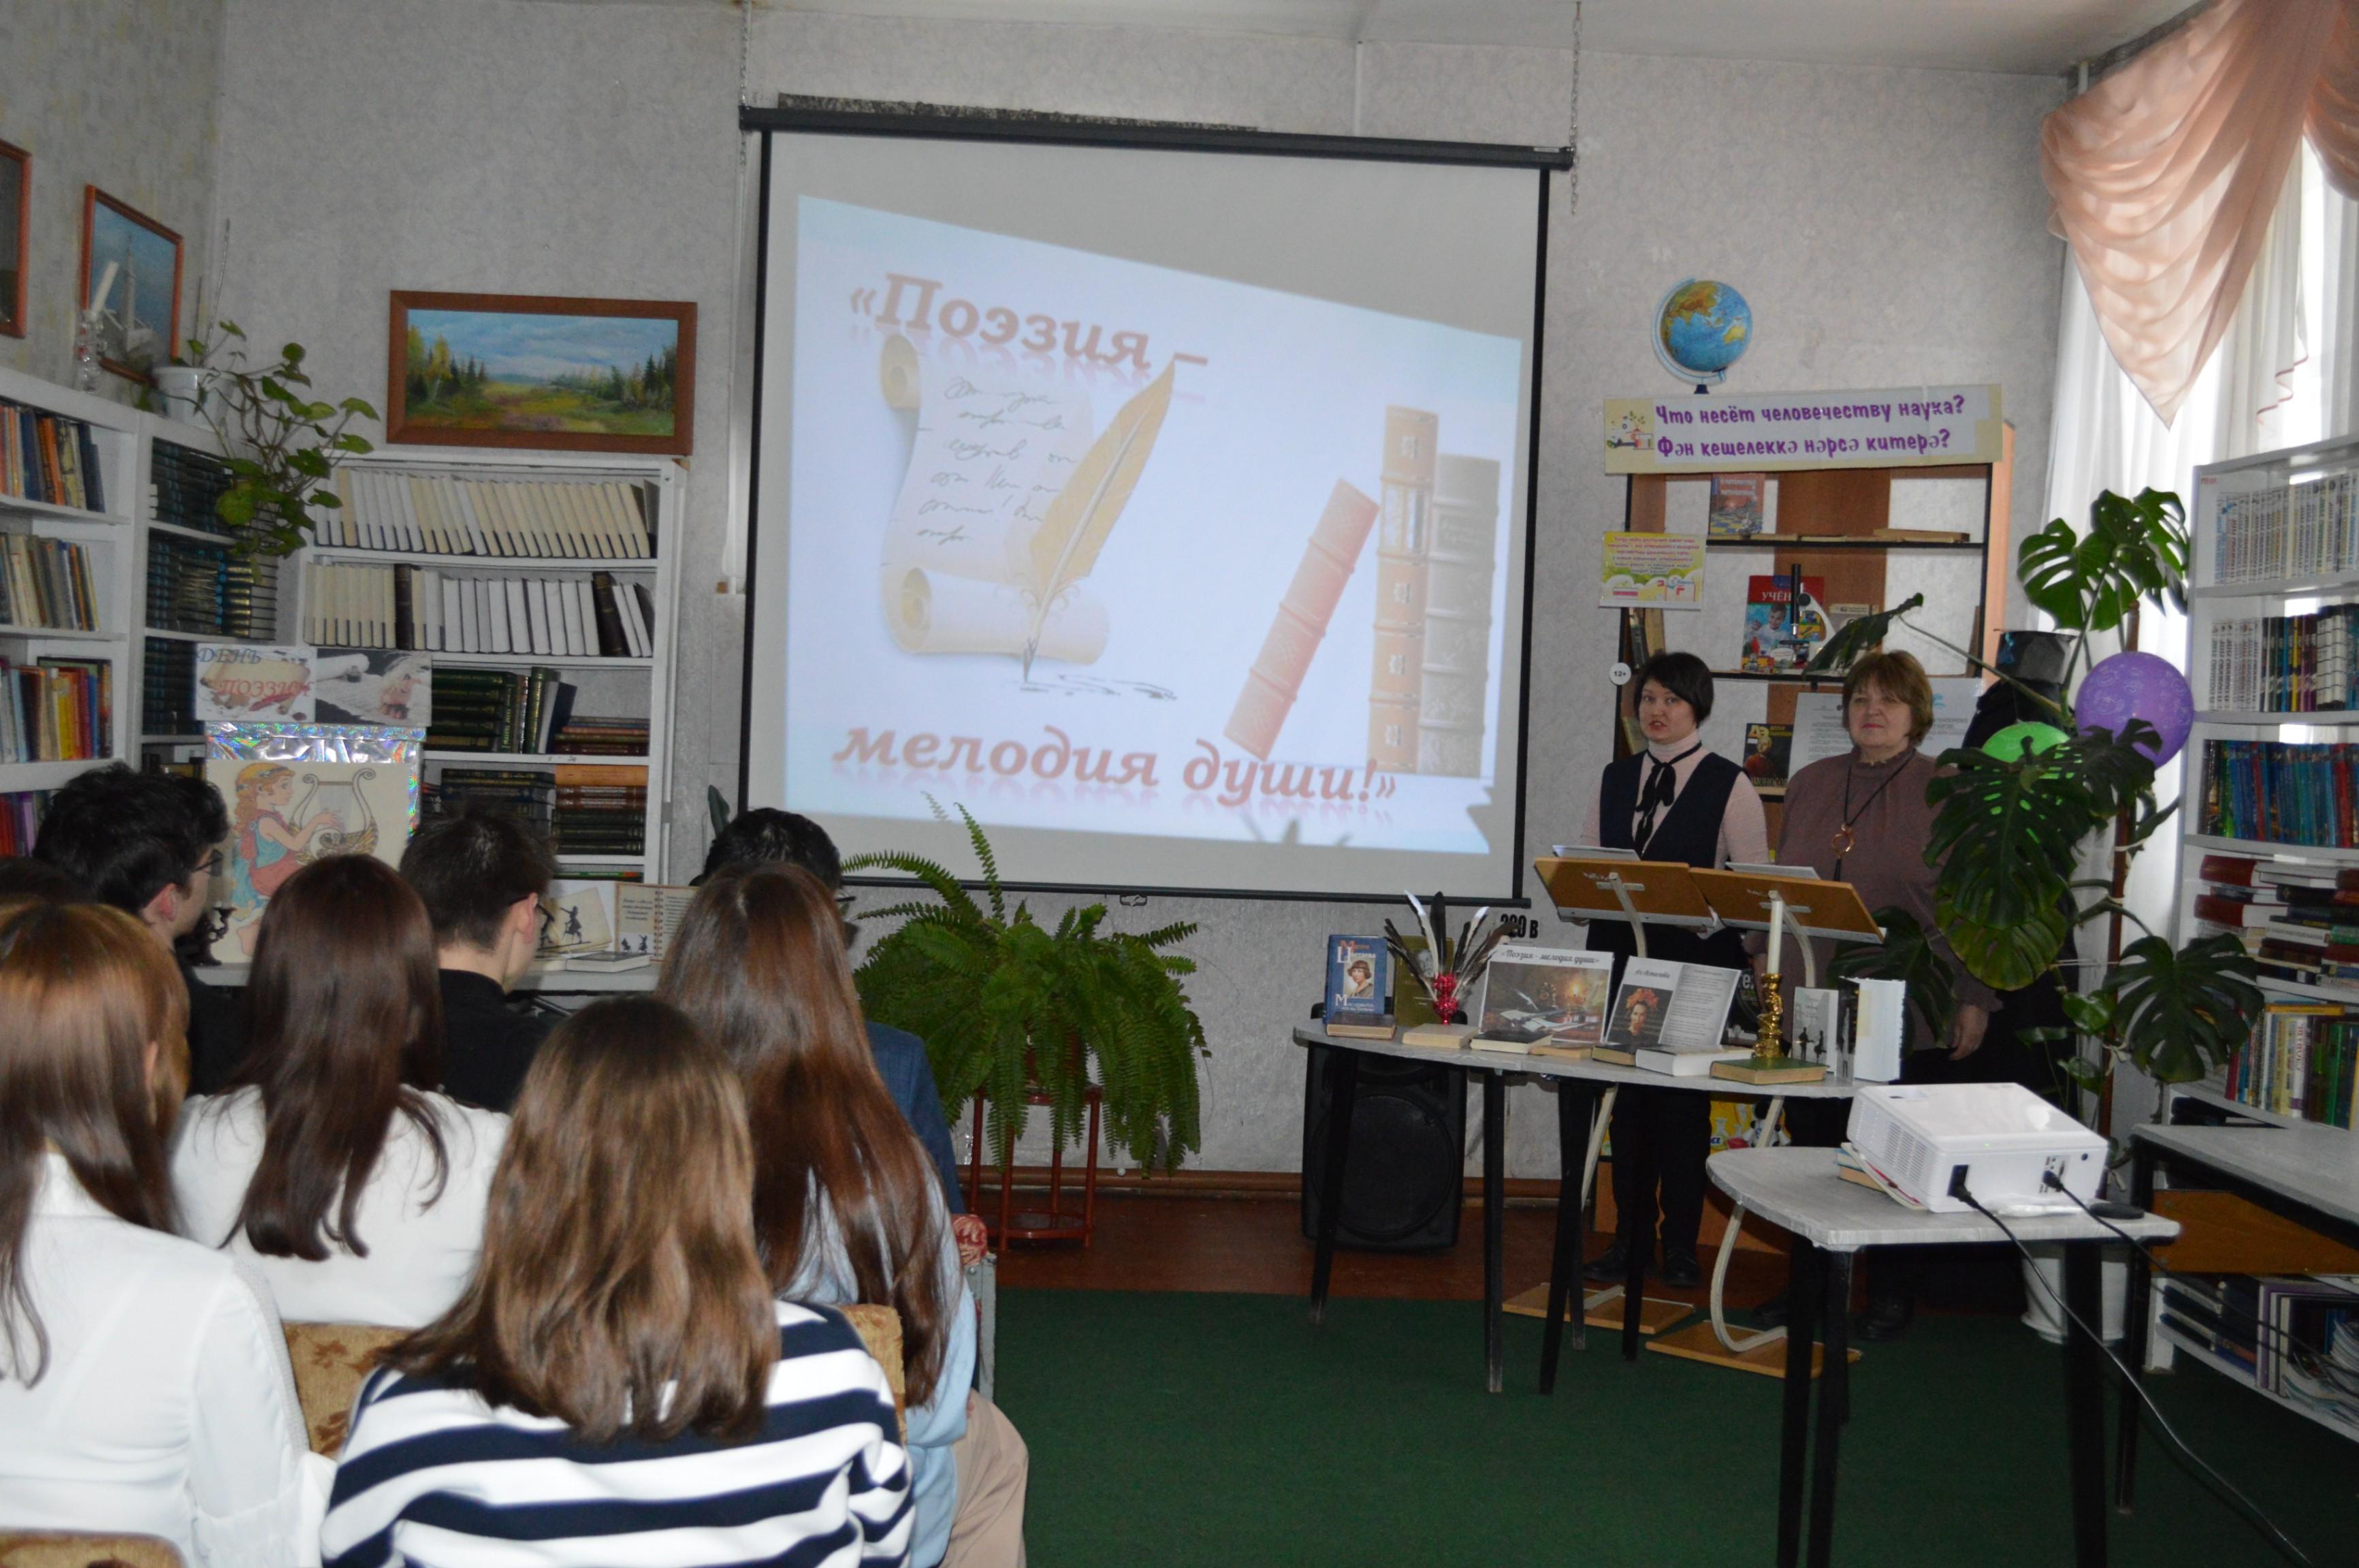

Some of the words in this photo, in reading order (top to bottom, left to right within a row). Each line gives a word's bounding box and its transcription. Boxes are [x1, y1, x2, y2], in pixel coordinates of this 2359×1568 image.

[850, 272, 1153, 372] «Поэзия
[1656, 406, 1693, 423] Что
[1700, 406, 1755, 423] несёт
[1761, 404, 1891, 422] человечеству
[1899, 395, 1965, 420] наука?
[1657, 436, 1695, 457] Фән
[1701, 440, 1798, 456] кешелеккә
[1804, 438, 1859, 458] нәрсә
[1866, 429, 1951, 453] китерә?
[1761, 590, 1792, 602] УЧЁН
[833, 725, 1159, 790] мелодия
[1183, 738, 1397, 807] души!»
